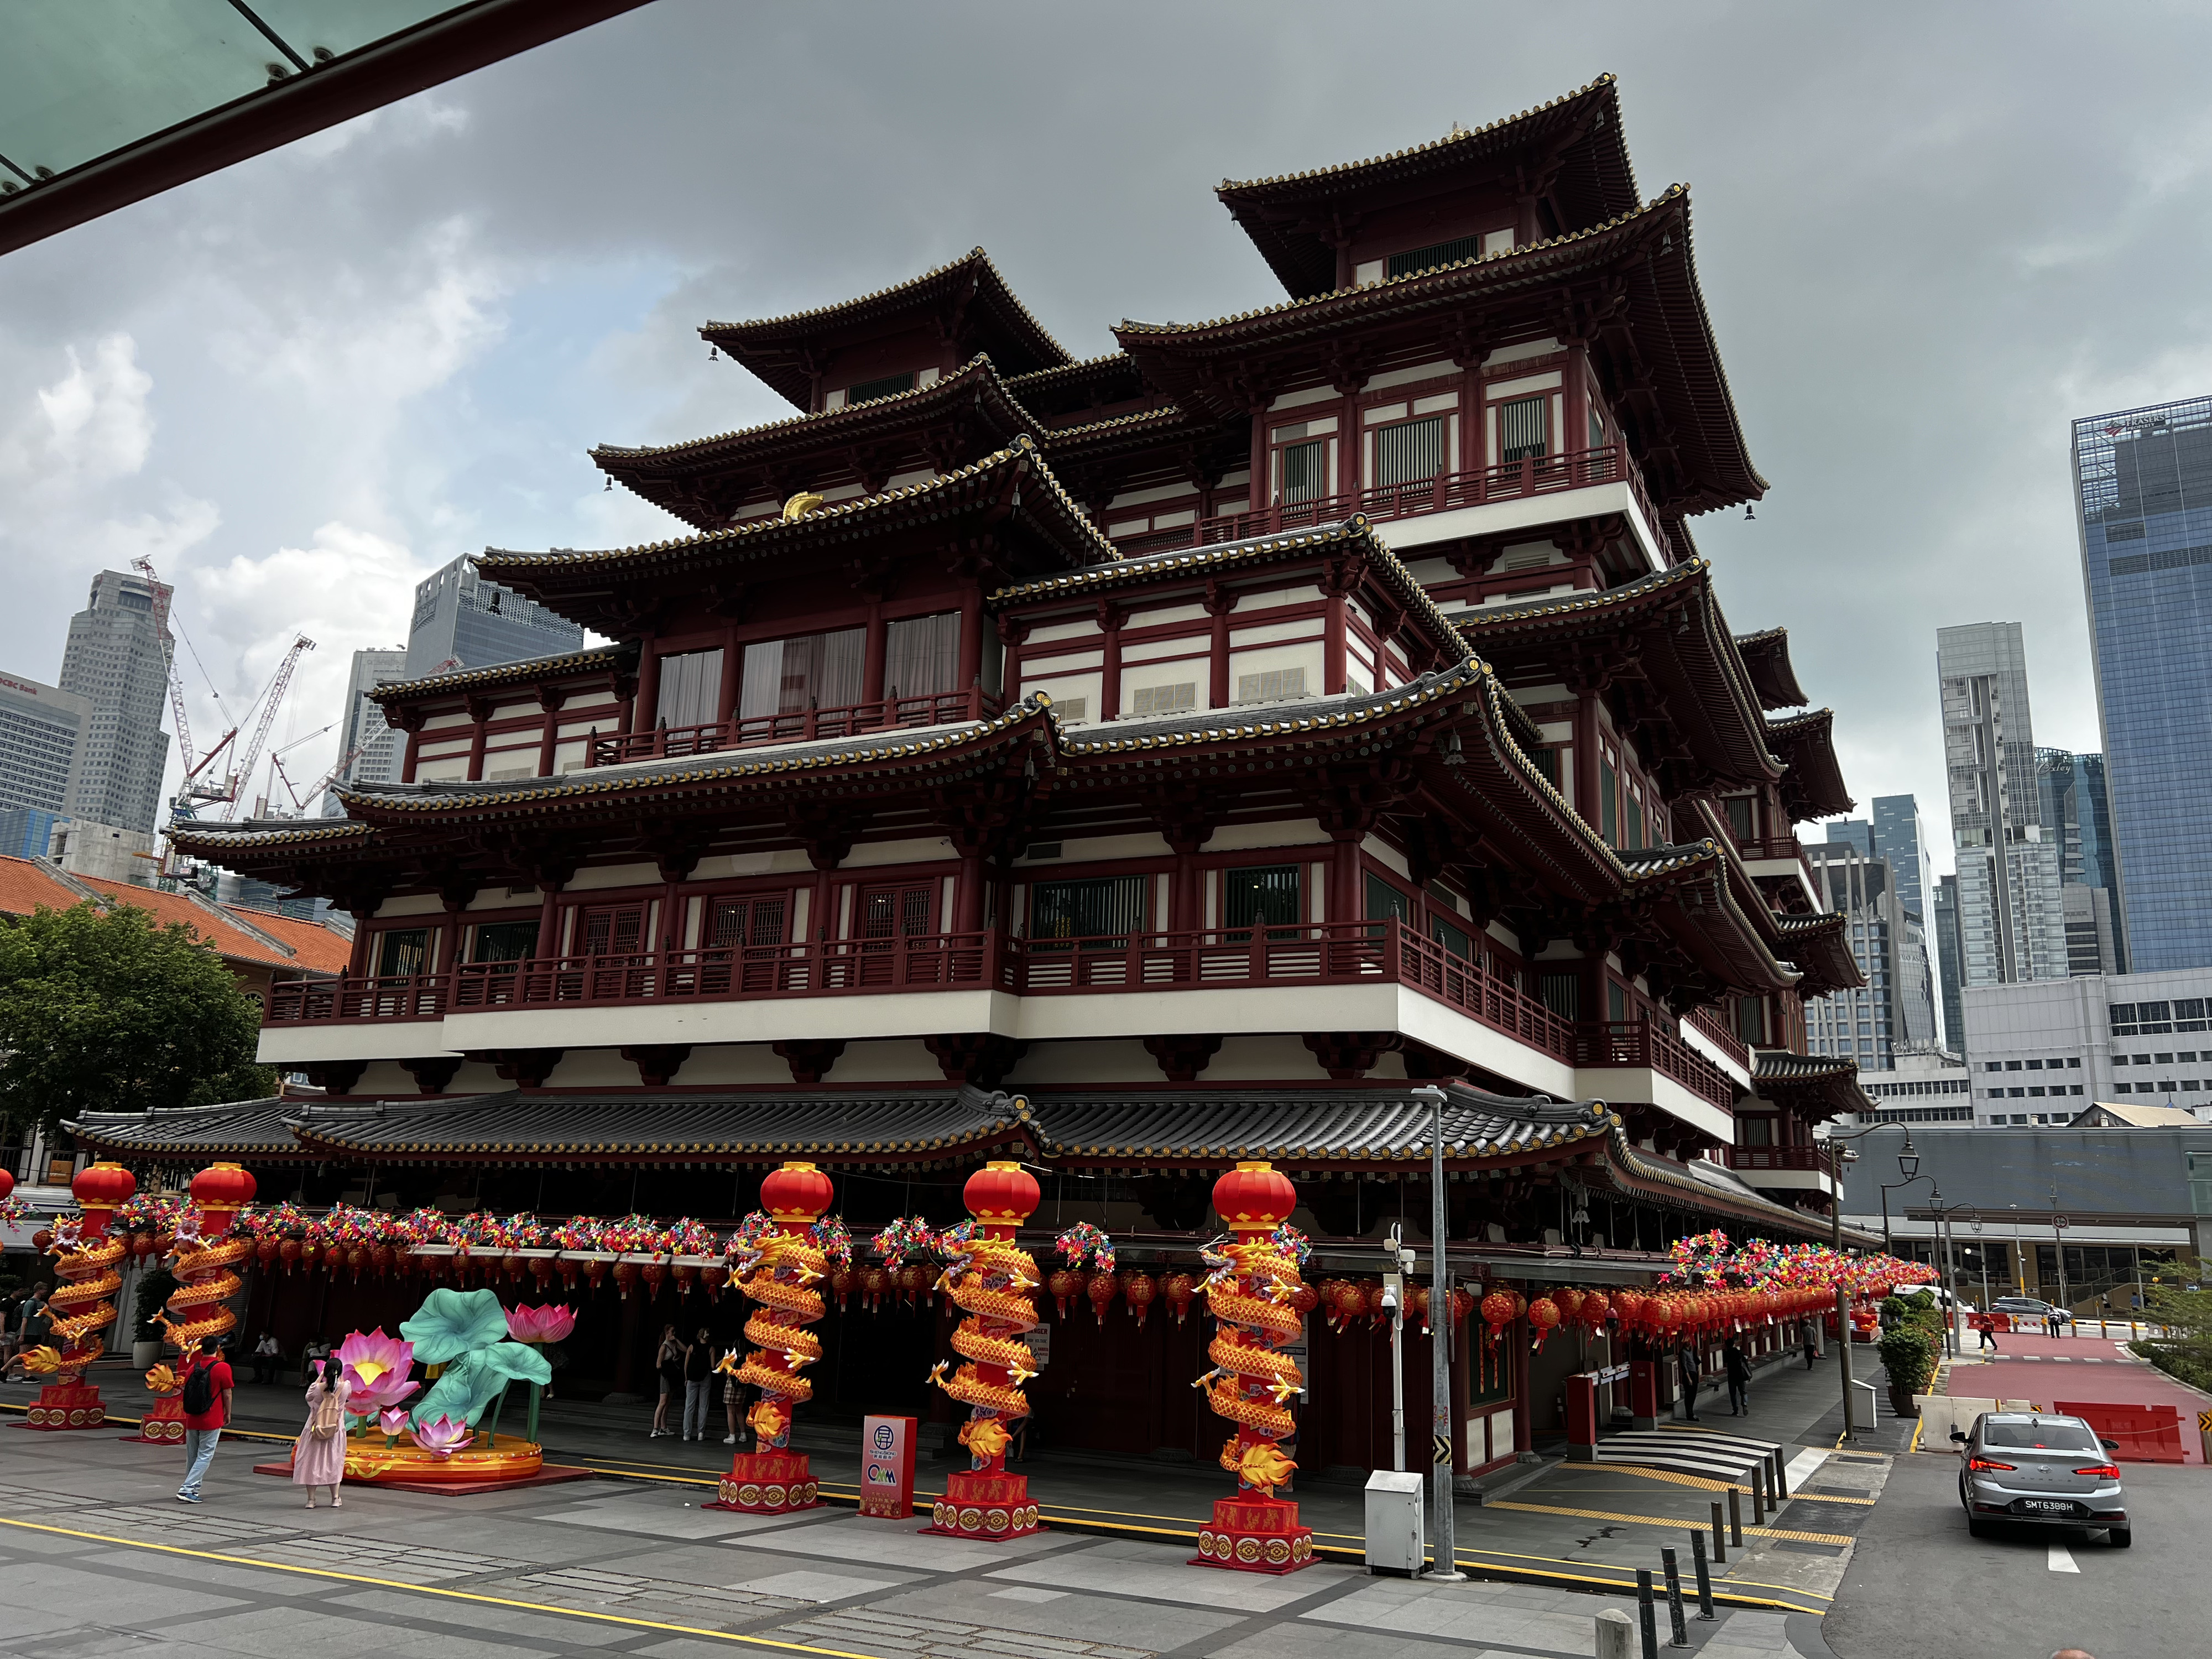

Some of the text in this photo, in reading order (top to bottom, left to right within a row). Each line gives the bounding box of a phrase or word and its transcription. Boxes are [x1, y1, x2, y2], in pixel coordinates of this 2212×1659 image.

[2126, 414, 2164, 426] FRASERS
[2127, 422, 2155, 431] PROPERTY
[19, 684, 38, 695] Bank
[2037, 761, 2071, 775] Oxley
